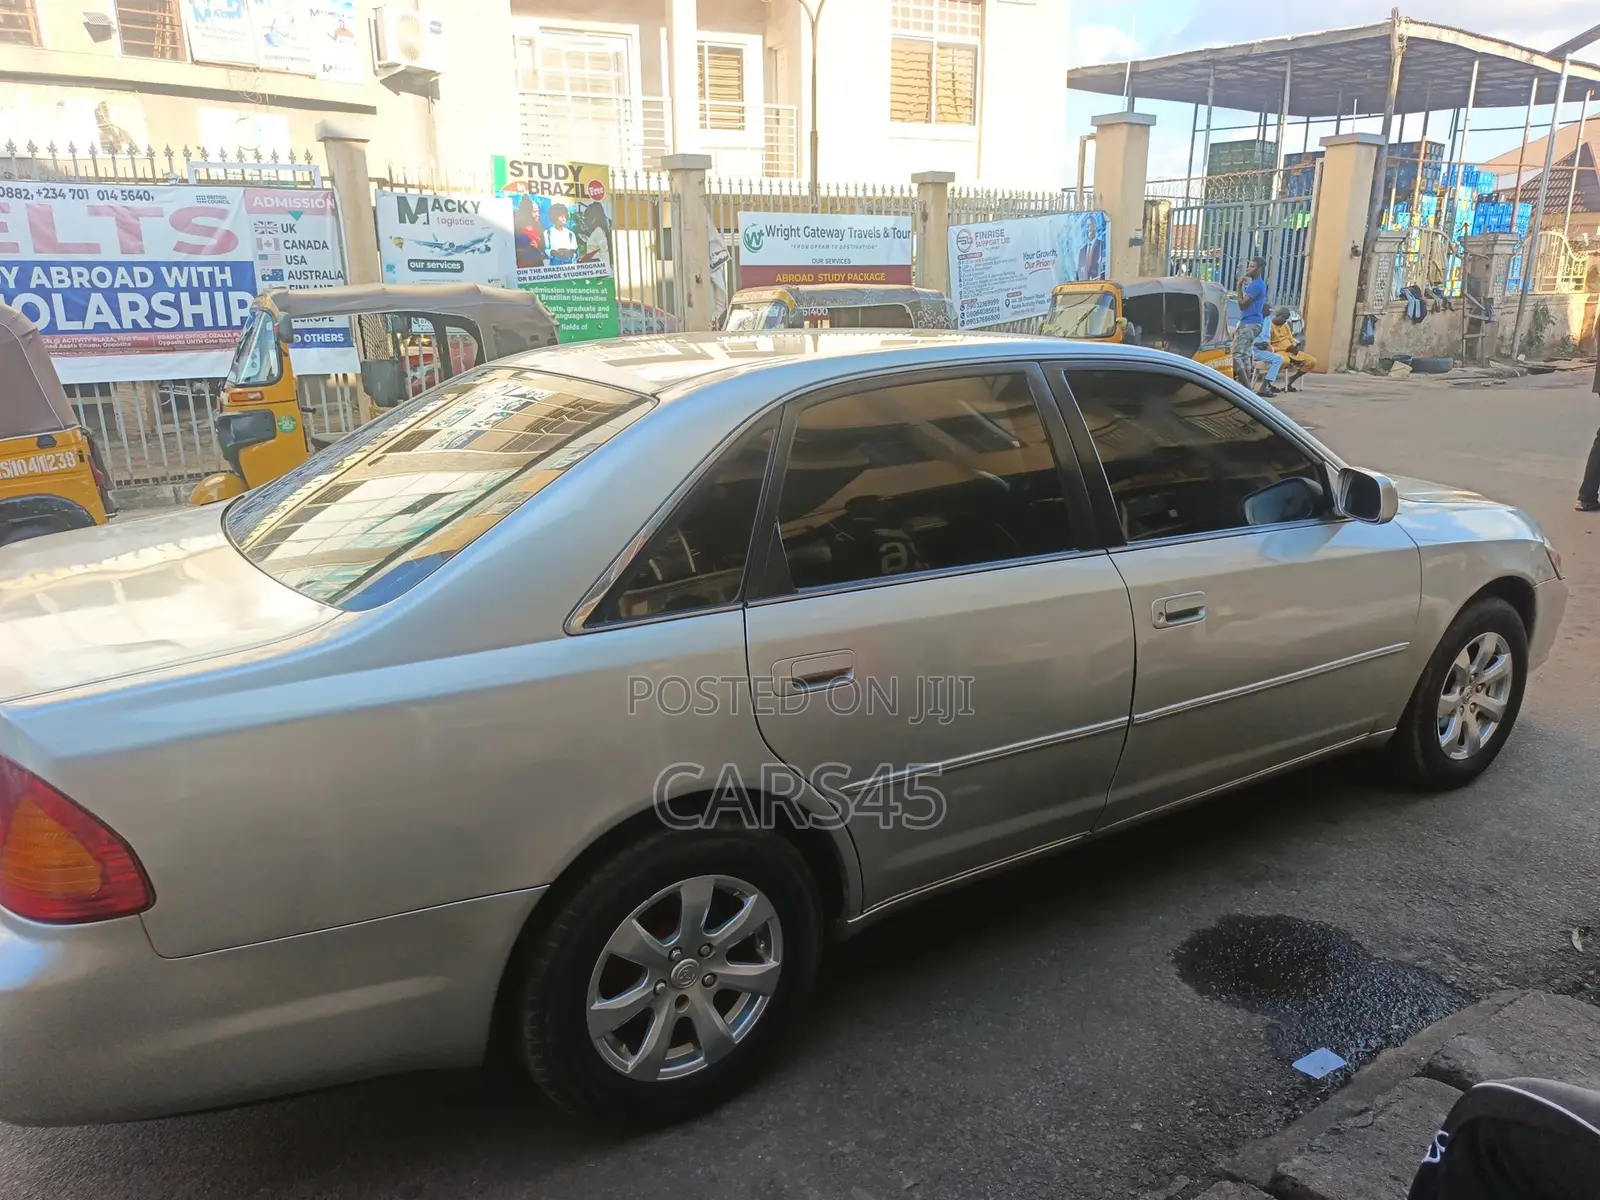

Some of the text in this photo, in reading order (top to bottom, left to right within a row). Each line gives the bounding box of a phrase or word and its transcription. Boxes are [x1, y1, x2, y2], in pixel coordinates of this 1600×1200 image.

[508, 159, 584, 182] STUDY
[36, 188, 67, 200] +234
[69, 188, 89, 200] 701
[97, 190, 118, 201] 014
[527, 179, 590, 199] BRAZIL
[396, 195, 481, 226] MACKY
[281, 223, 297, 234] UK
[765, 223, 800, 240] Wright
[803, 225, 845, 241] Gateway
[848, 226, 881, 239] Travels
[883, 227, 889, 238] &
[974, 229, 1005, 240] FINRISE
[283, 239, 329, 251] CANADA
[285, 254, 308, 265] USA
[1023, 251, 1035, 260] Your
[409, 260, 461, 270] our services
[1024, 261, 1035, 270] Our
[30, 265, 154, 289] ABROAD
[160, 265, 233, 287] WITH
[287, 269, 344, 281] AUSTRALIA
[776, 273, 886, 282] ABROAD STUDY PACKAGE
[0, 290, 253, 331] OLARSHIP
[303, 334, 345, 343] OTHERS
